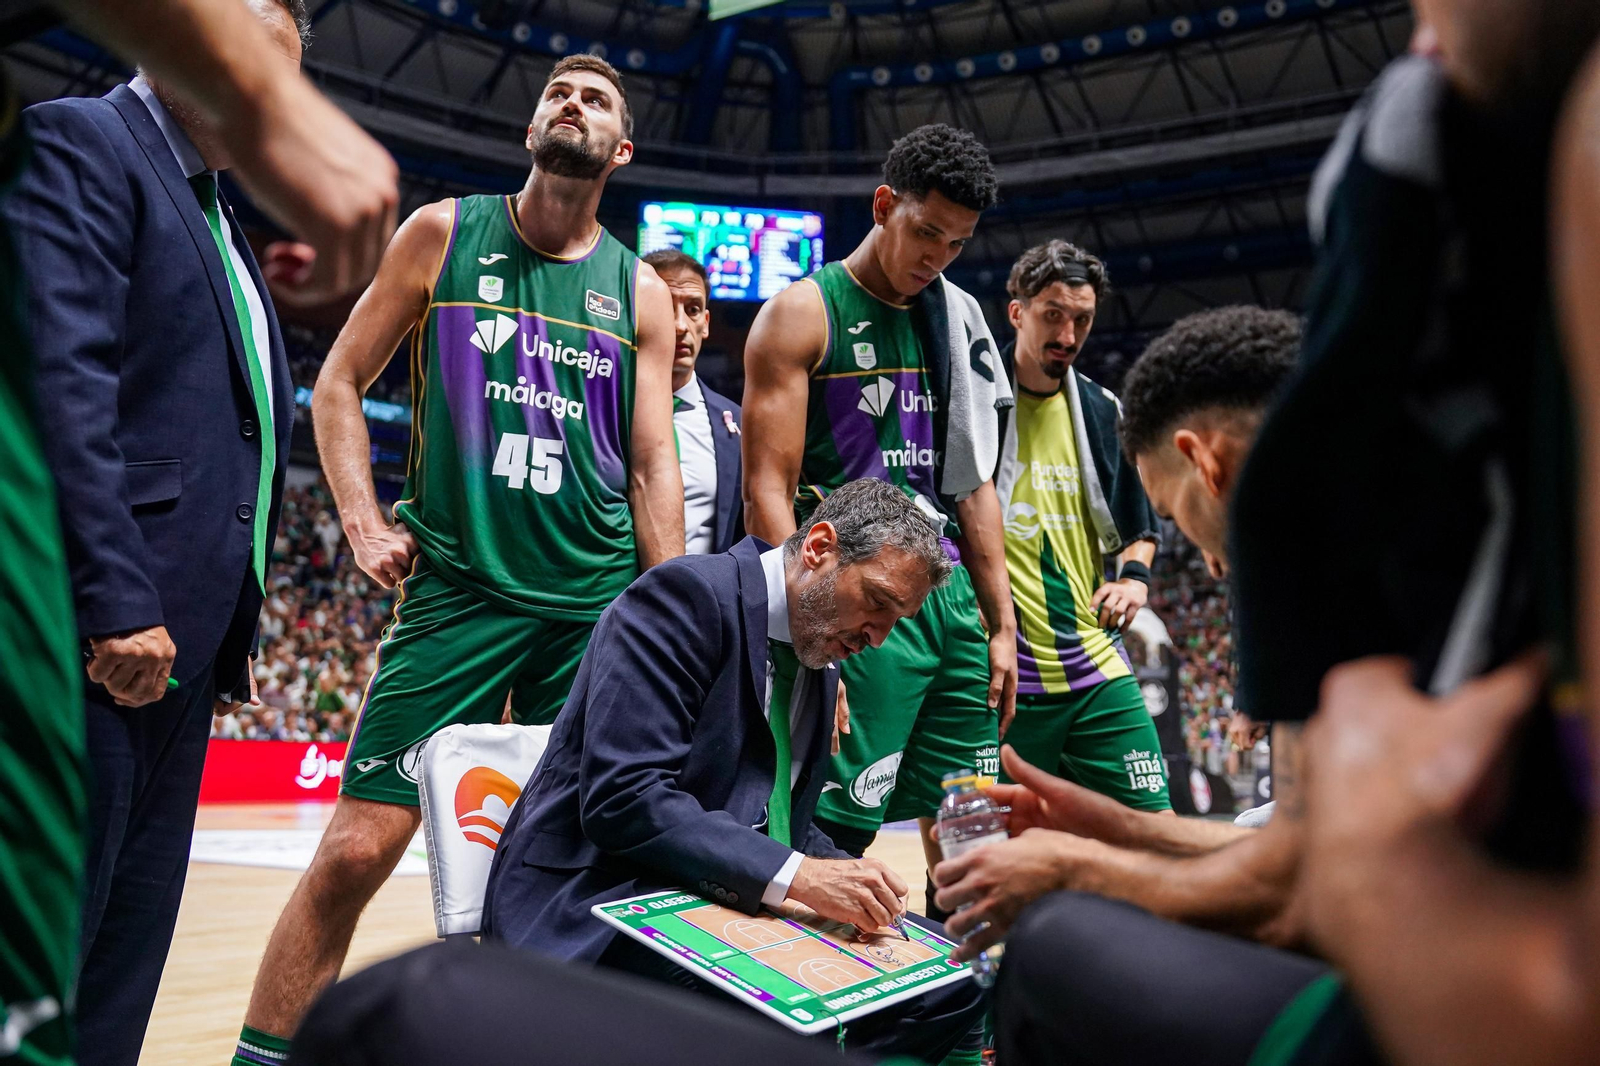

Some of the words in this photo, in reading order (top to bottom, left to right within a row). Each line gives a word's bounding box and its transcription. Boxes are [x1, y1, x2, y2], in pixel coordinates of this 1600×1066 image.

[588, 304, 617, 317] endesa
[522, 332, 614, 379] Unicaja
[491, 432, 564, 495] 45
[983, 756, 1000, 773] m
[1123, 749, 1151, 762] sabor
[1132, 753, 1163, 775] má
[1128, 771, 1166, 793] laga
[711, 966, 763, 996] NAVARRO
[823, 986, 882, 1010] UNICAJA
[874, 963, 948, 993] BALONCESTO
